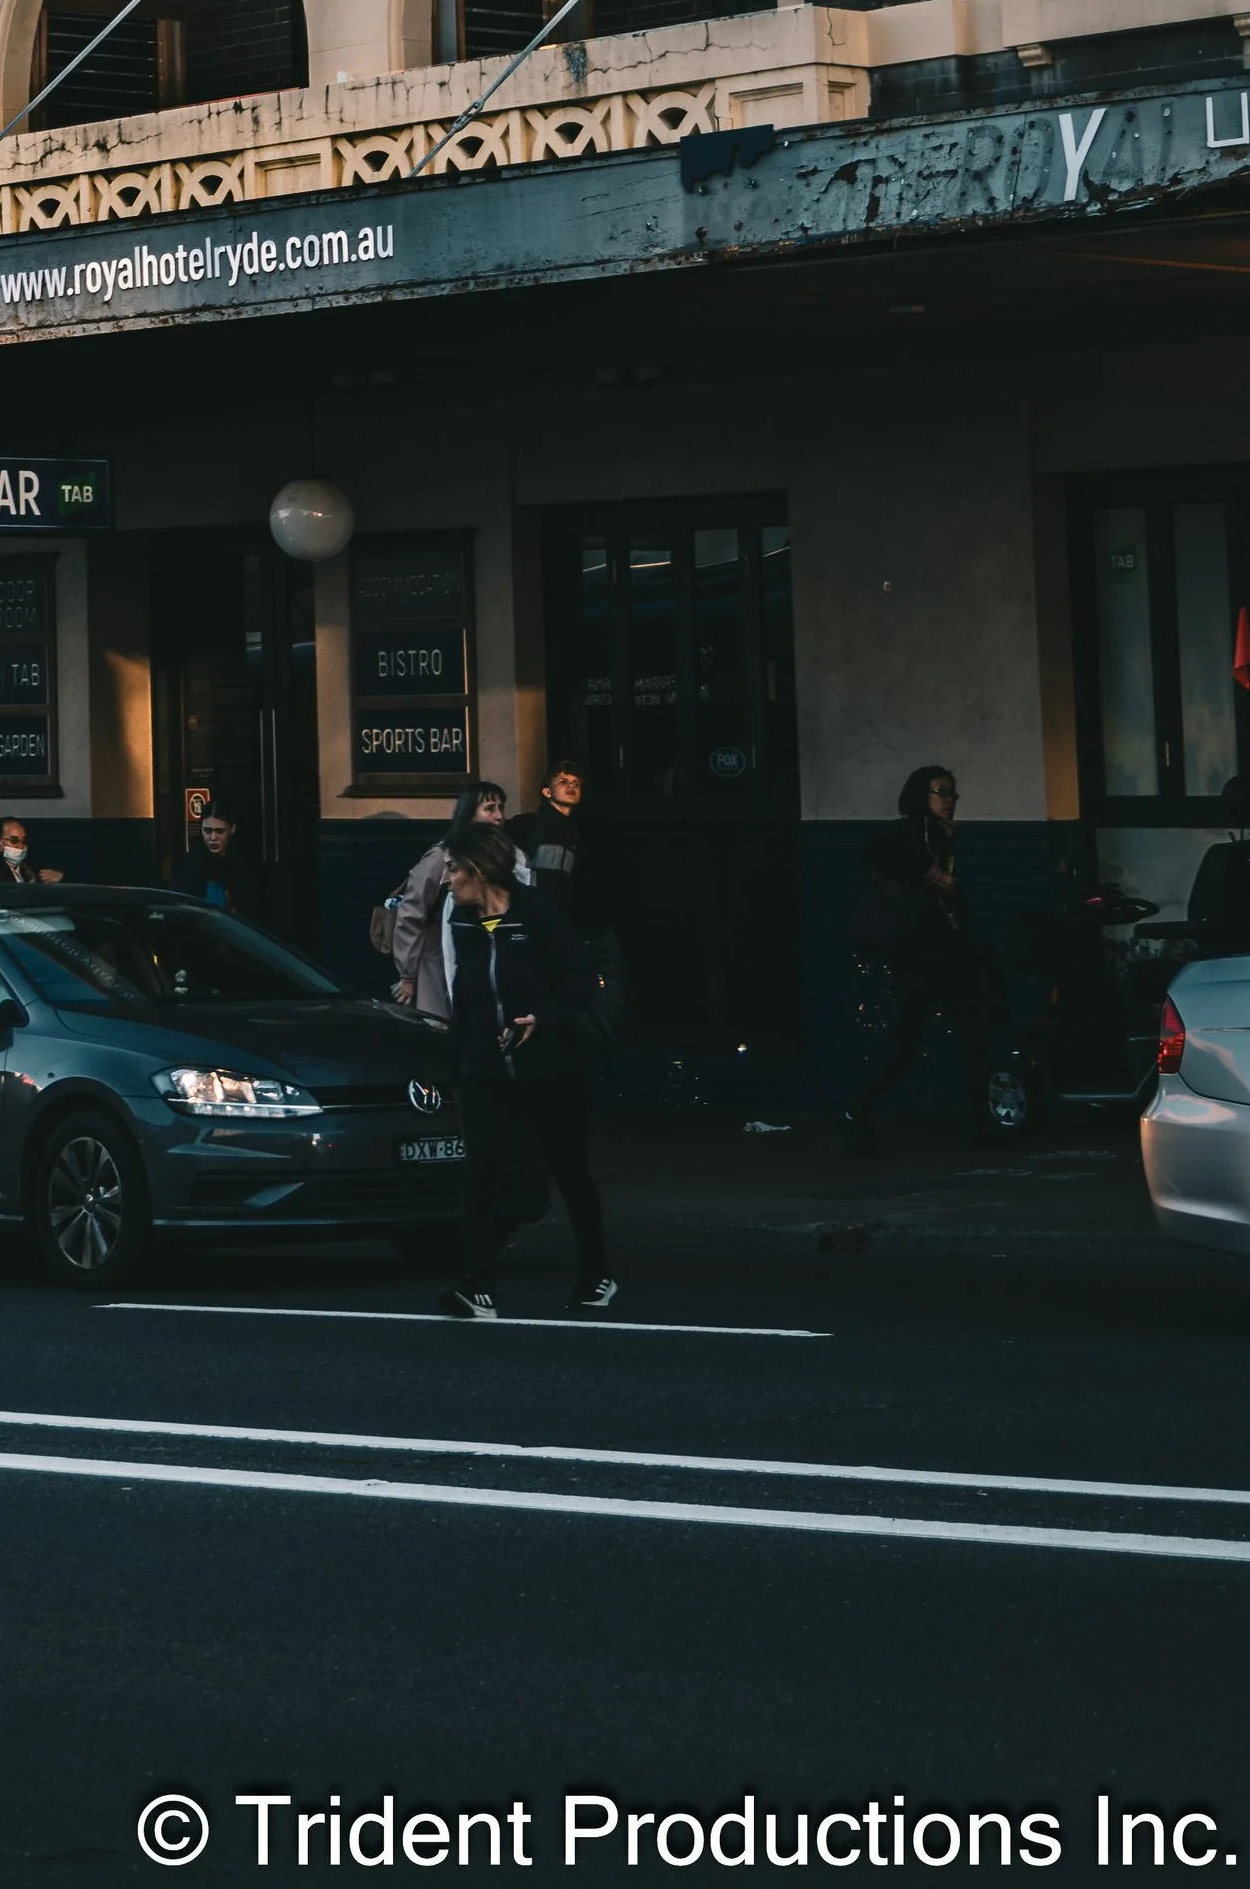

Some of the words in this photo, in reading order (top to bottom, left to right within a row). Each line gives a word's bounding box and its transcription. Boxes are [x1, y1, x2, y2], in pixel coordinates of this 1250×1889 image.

[0, 224, 395, 303] www.royalhotelryde.com.au
[61, 483, 94, 504] TAB
[10, 663, 41, 686] TAB
[377, 648, 443, 677] BISTRO
[361, 728, 426, 754] SPORTS
[430, 727, 464, 754] BAR
[716, 752, 739, 766] FOX
